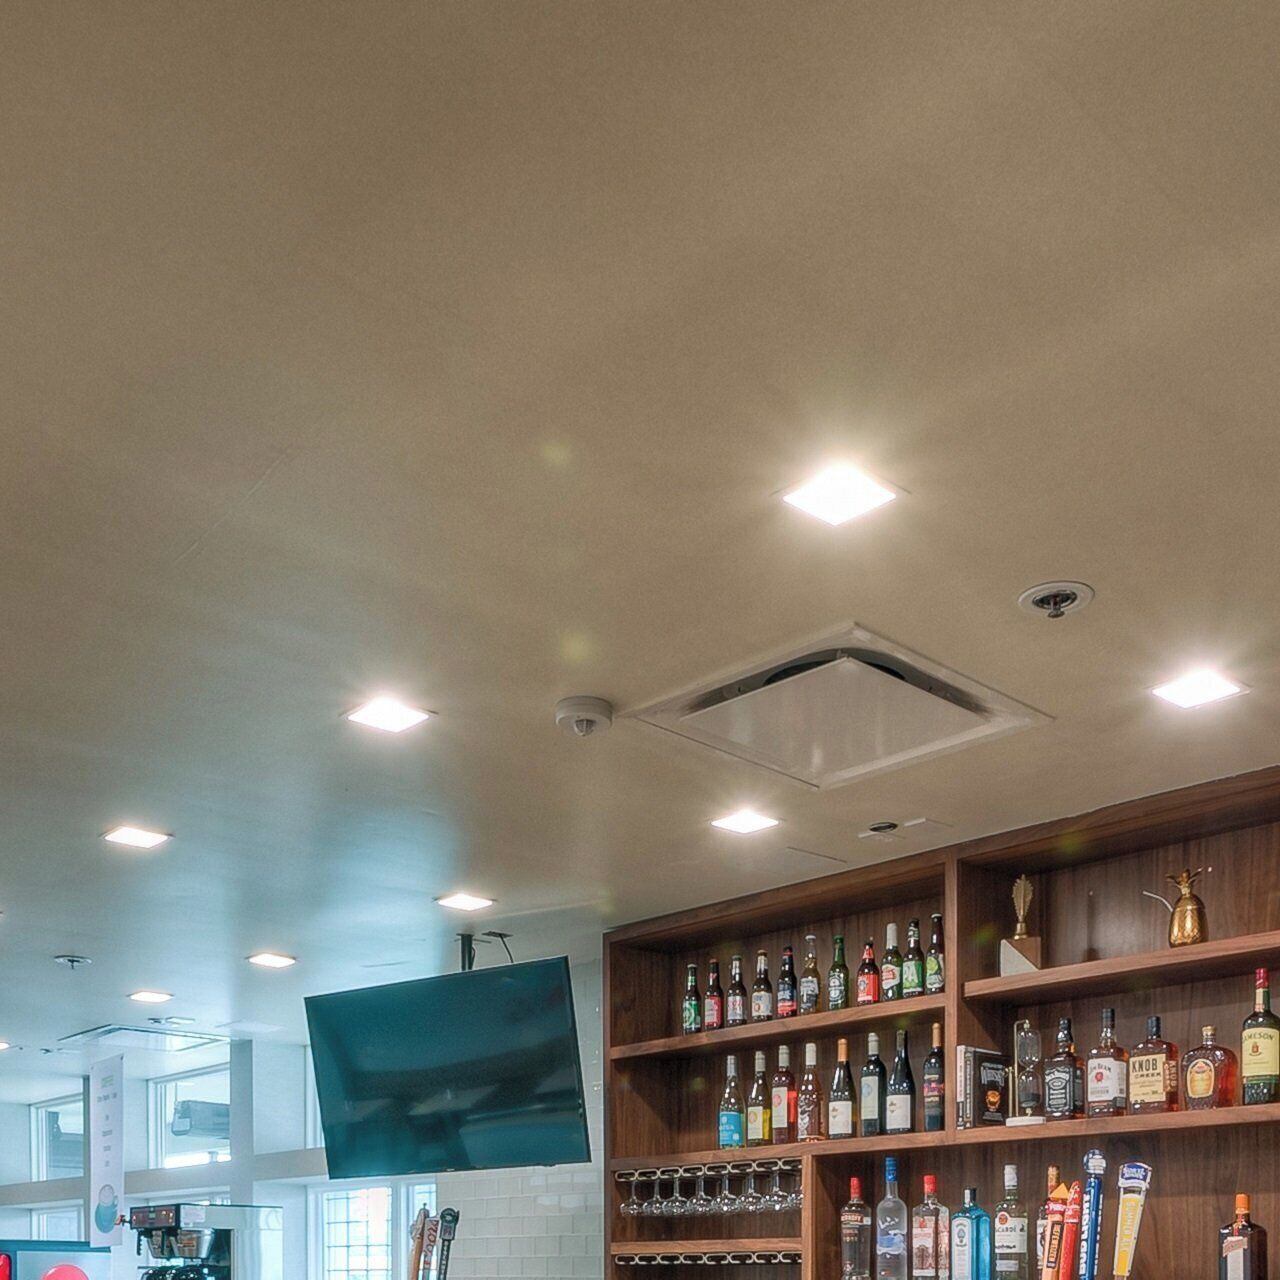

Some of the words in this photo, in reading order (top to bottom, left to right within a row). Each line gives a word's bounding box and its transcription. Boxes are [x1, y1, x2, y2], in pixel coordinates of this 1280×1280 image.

[1131, 1058, 1158, 1073] KNOB
[1081, 1193, 1091, 1240] LIGHT
[1079, 1240, 1089, 1275] BUD
